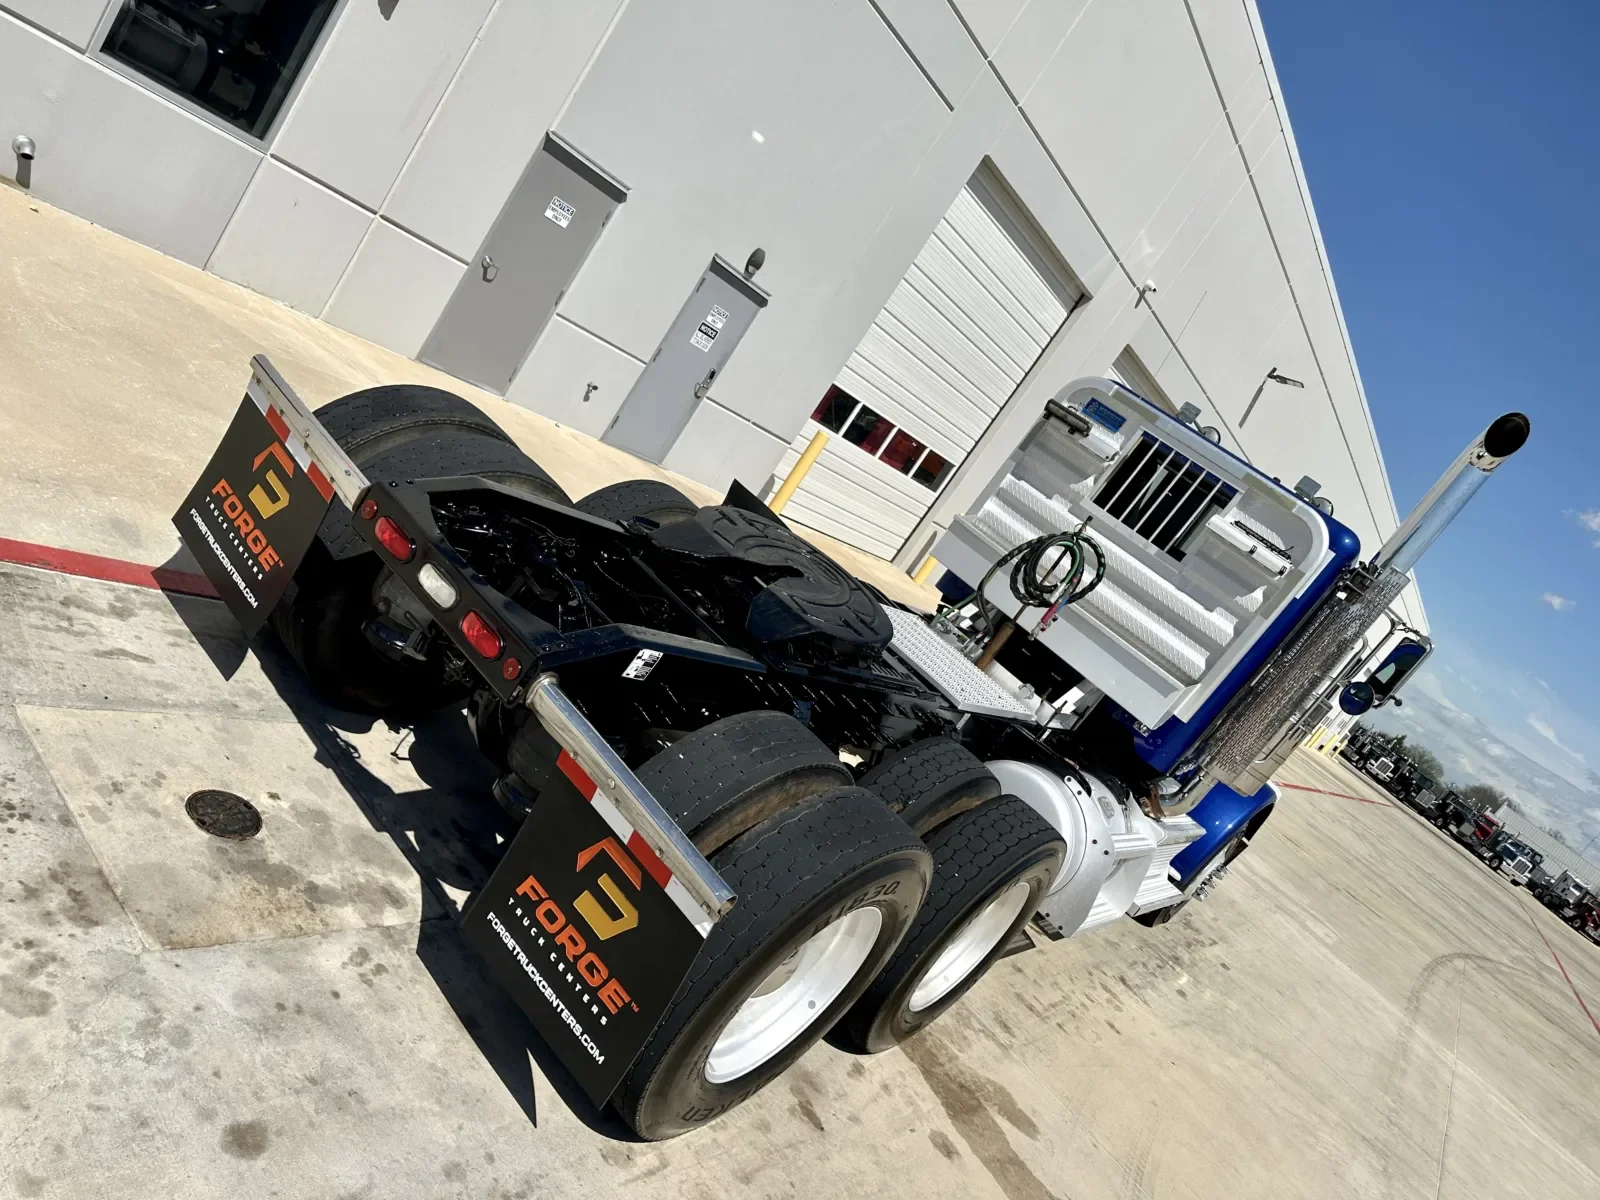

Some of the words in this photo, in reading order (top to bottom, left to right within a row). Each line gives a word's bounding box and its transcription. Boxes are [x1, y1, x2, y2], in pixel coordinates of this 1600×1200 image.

[551, 198, 574, 215] NOTICE
[699, 323, 717, 338] NOTICE
[189, 507, 259, 609] FORGETRUCKCENTERS.COM
[205, 496, 228, 530] TRUCK
[229, 532, 263, 580] CENTERS
[211, 477, 280, 572] FORGE
[486, 911, 605, 1065] FORGETRUCKCENTERS.COM
[508, 897, 545, 946] TRUCK
[549, 952, 607, 1026] CENTERS
[515, 874, 631, 1015] FORGE
